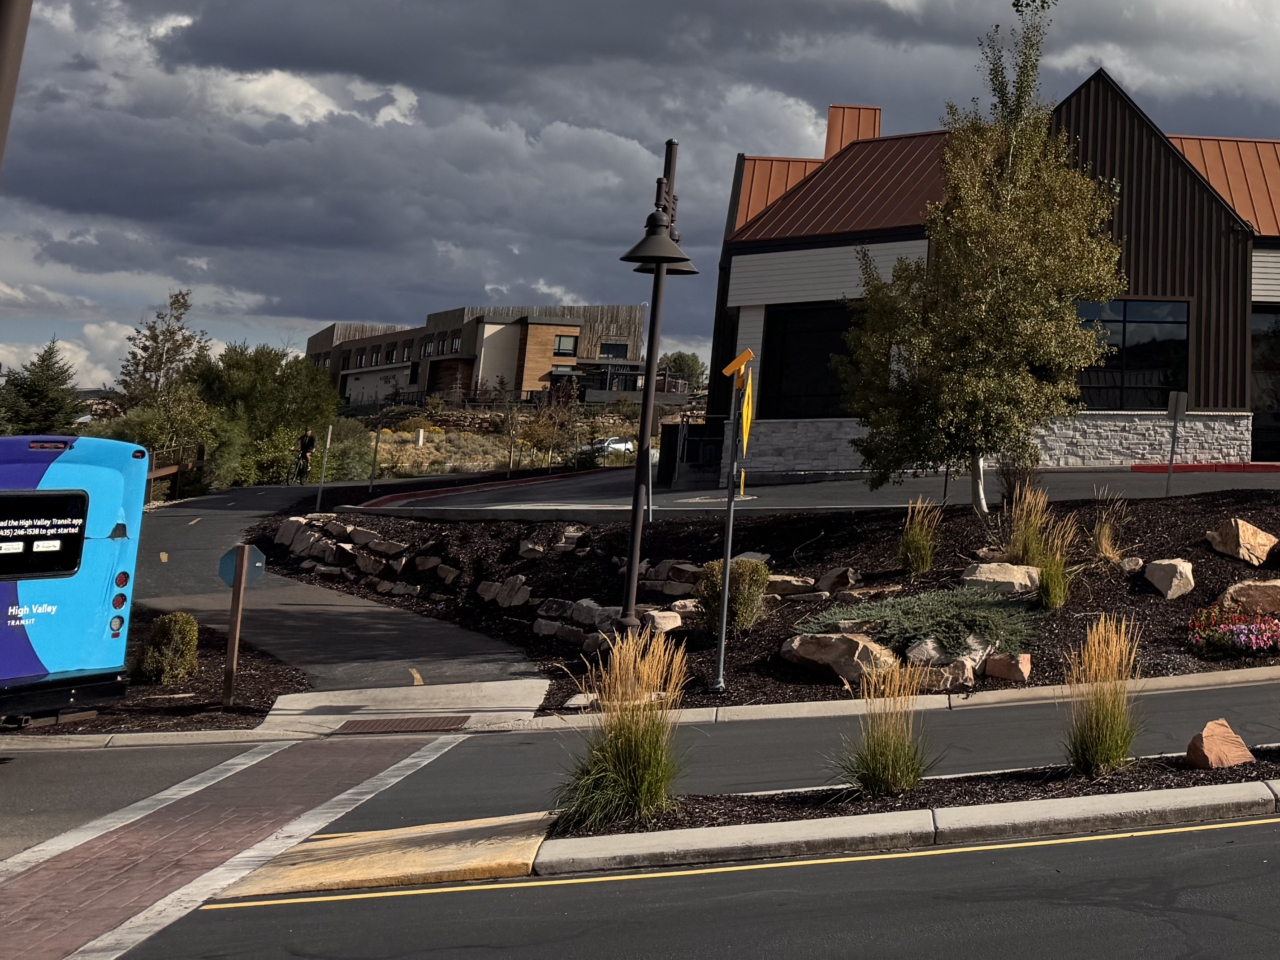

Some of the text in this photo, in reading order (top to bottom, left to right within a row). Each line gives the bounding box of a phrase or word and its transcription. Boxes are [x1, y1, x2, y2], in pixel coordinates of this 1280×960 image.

[8, 519, 18, 527] the
[19, 519, 33, 528] High
[33, 518, 51, 527] Valley
[52, 517, 71, 525] Transit
[47, 528, 57, 536] get
[8, 603, 57, 617] High Valley
[7, 618, 36, 627] TRANSIT
